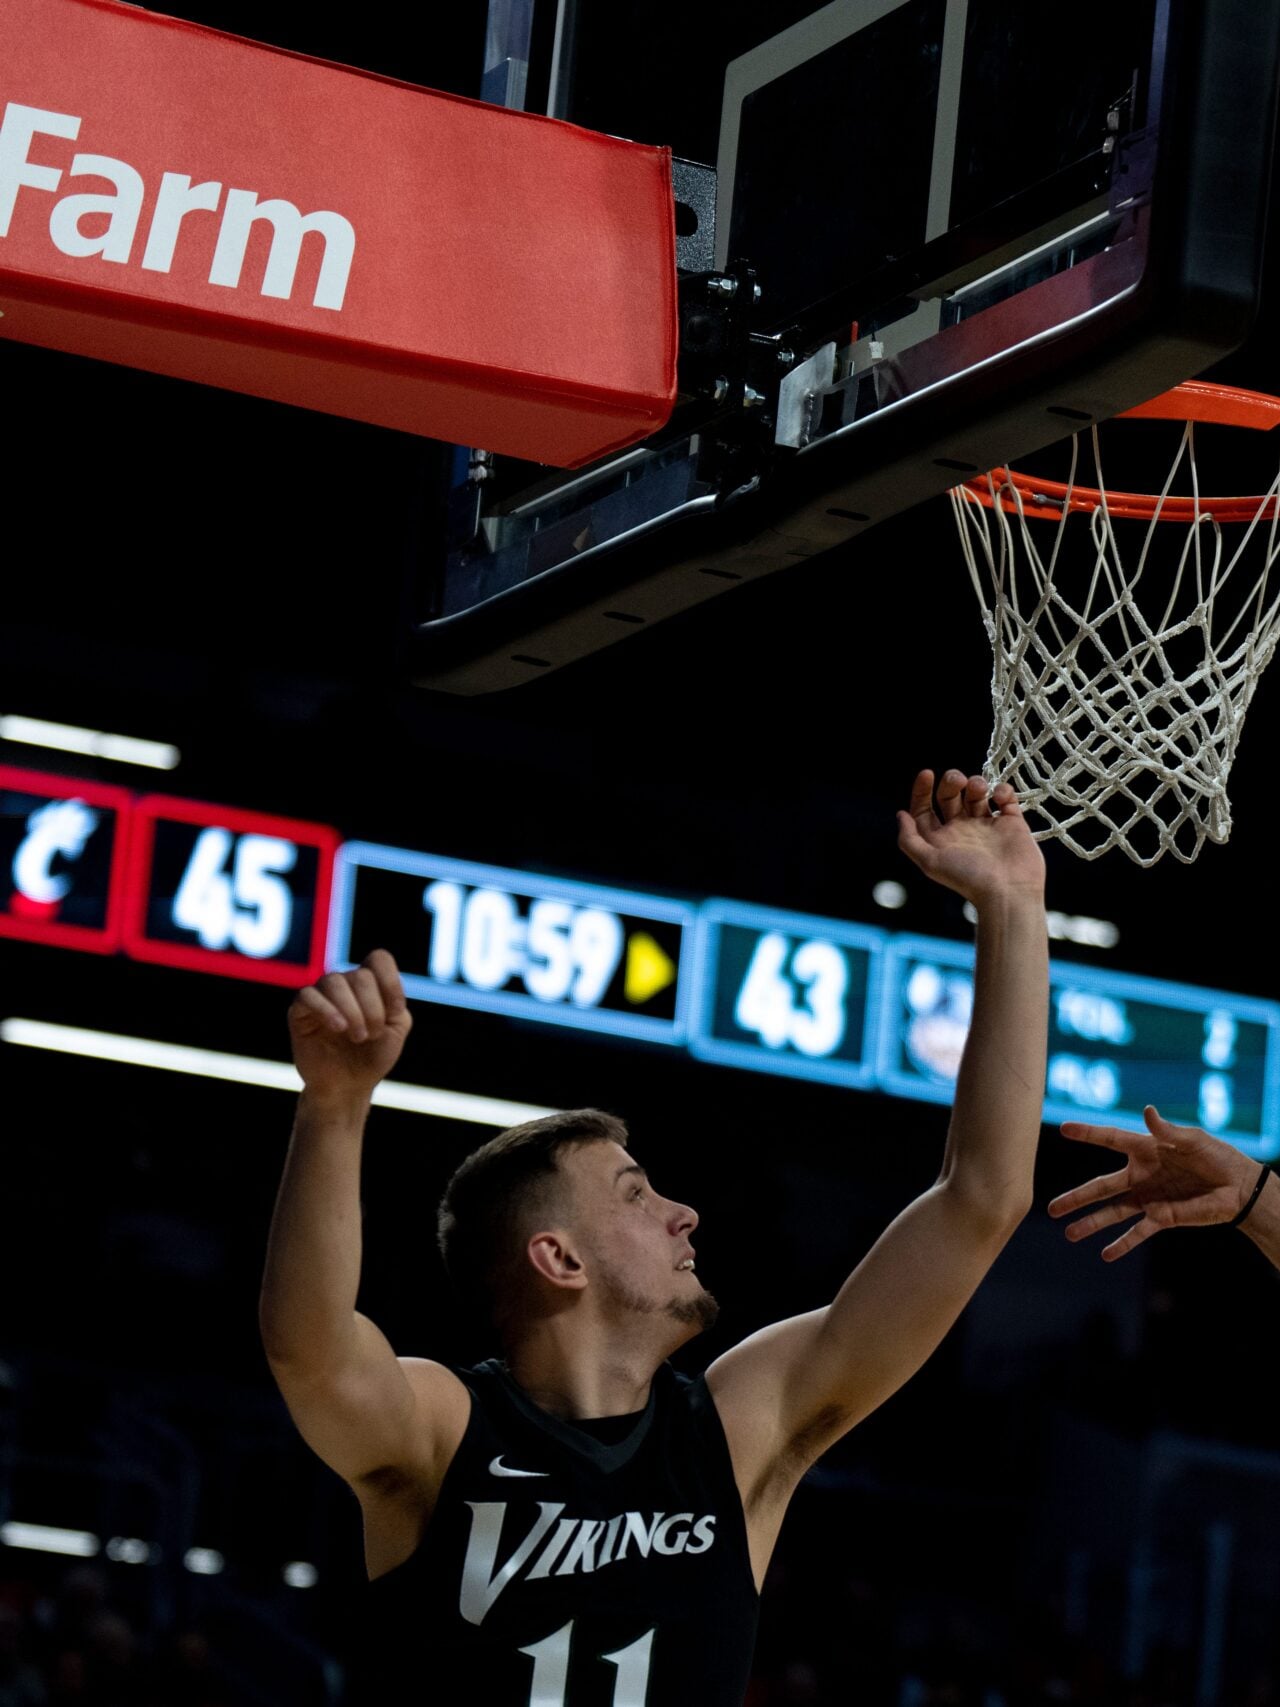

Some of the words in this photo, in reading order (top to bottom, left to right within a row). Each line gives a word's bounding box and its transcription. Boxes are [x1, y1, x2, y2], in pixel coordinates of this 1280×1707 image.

[0, 103, 356, 311] Farm
[172, 824, 298, 960] 45
[423, 878, 624, 1007] 10:59
[734, 930, 849, 1057] 43
[459, 1501, 717, 1627] VIKINGS
[517, 1618, 656, 1707] 11
